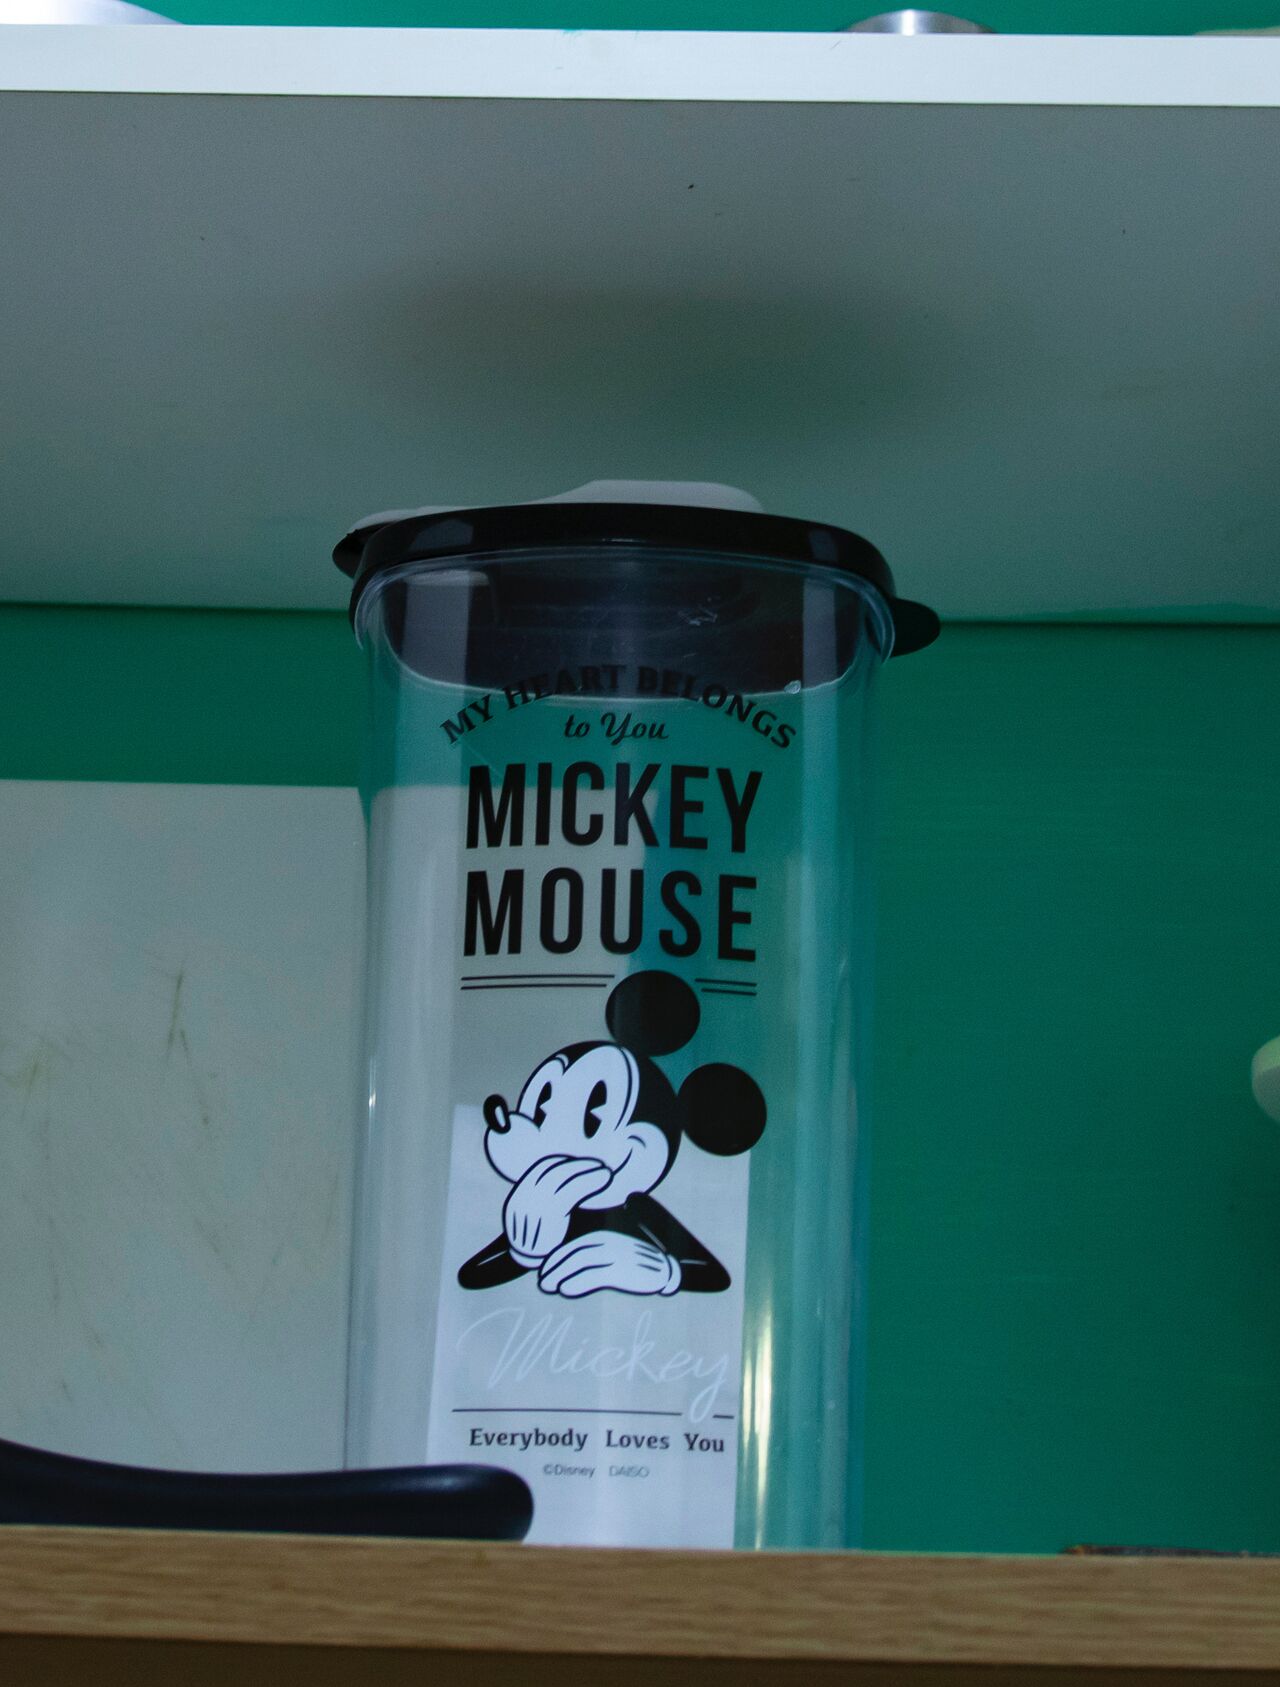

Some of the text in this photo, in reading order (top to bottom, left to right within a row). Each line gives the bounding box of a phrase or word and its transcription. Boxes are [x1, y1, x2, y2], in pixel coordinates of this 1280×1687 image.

[439, 664, 797, 749] MY HEART BELONGS
[564, 712, 669, 745] to You
[465, 761, 763, 853] MICKEY
[463, 867, 757, 962] MOUSE
[456, 1308, 730, 1422] Mickey
[469, 1428, 725, 1453] Everybody Loves You
